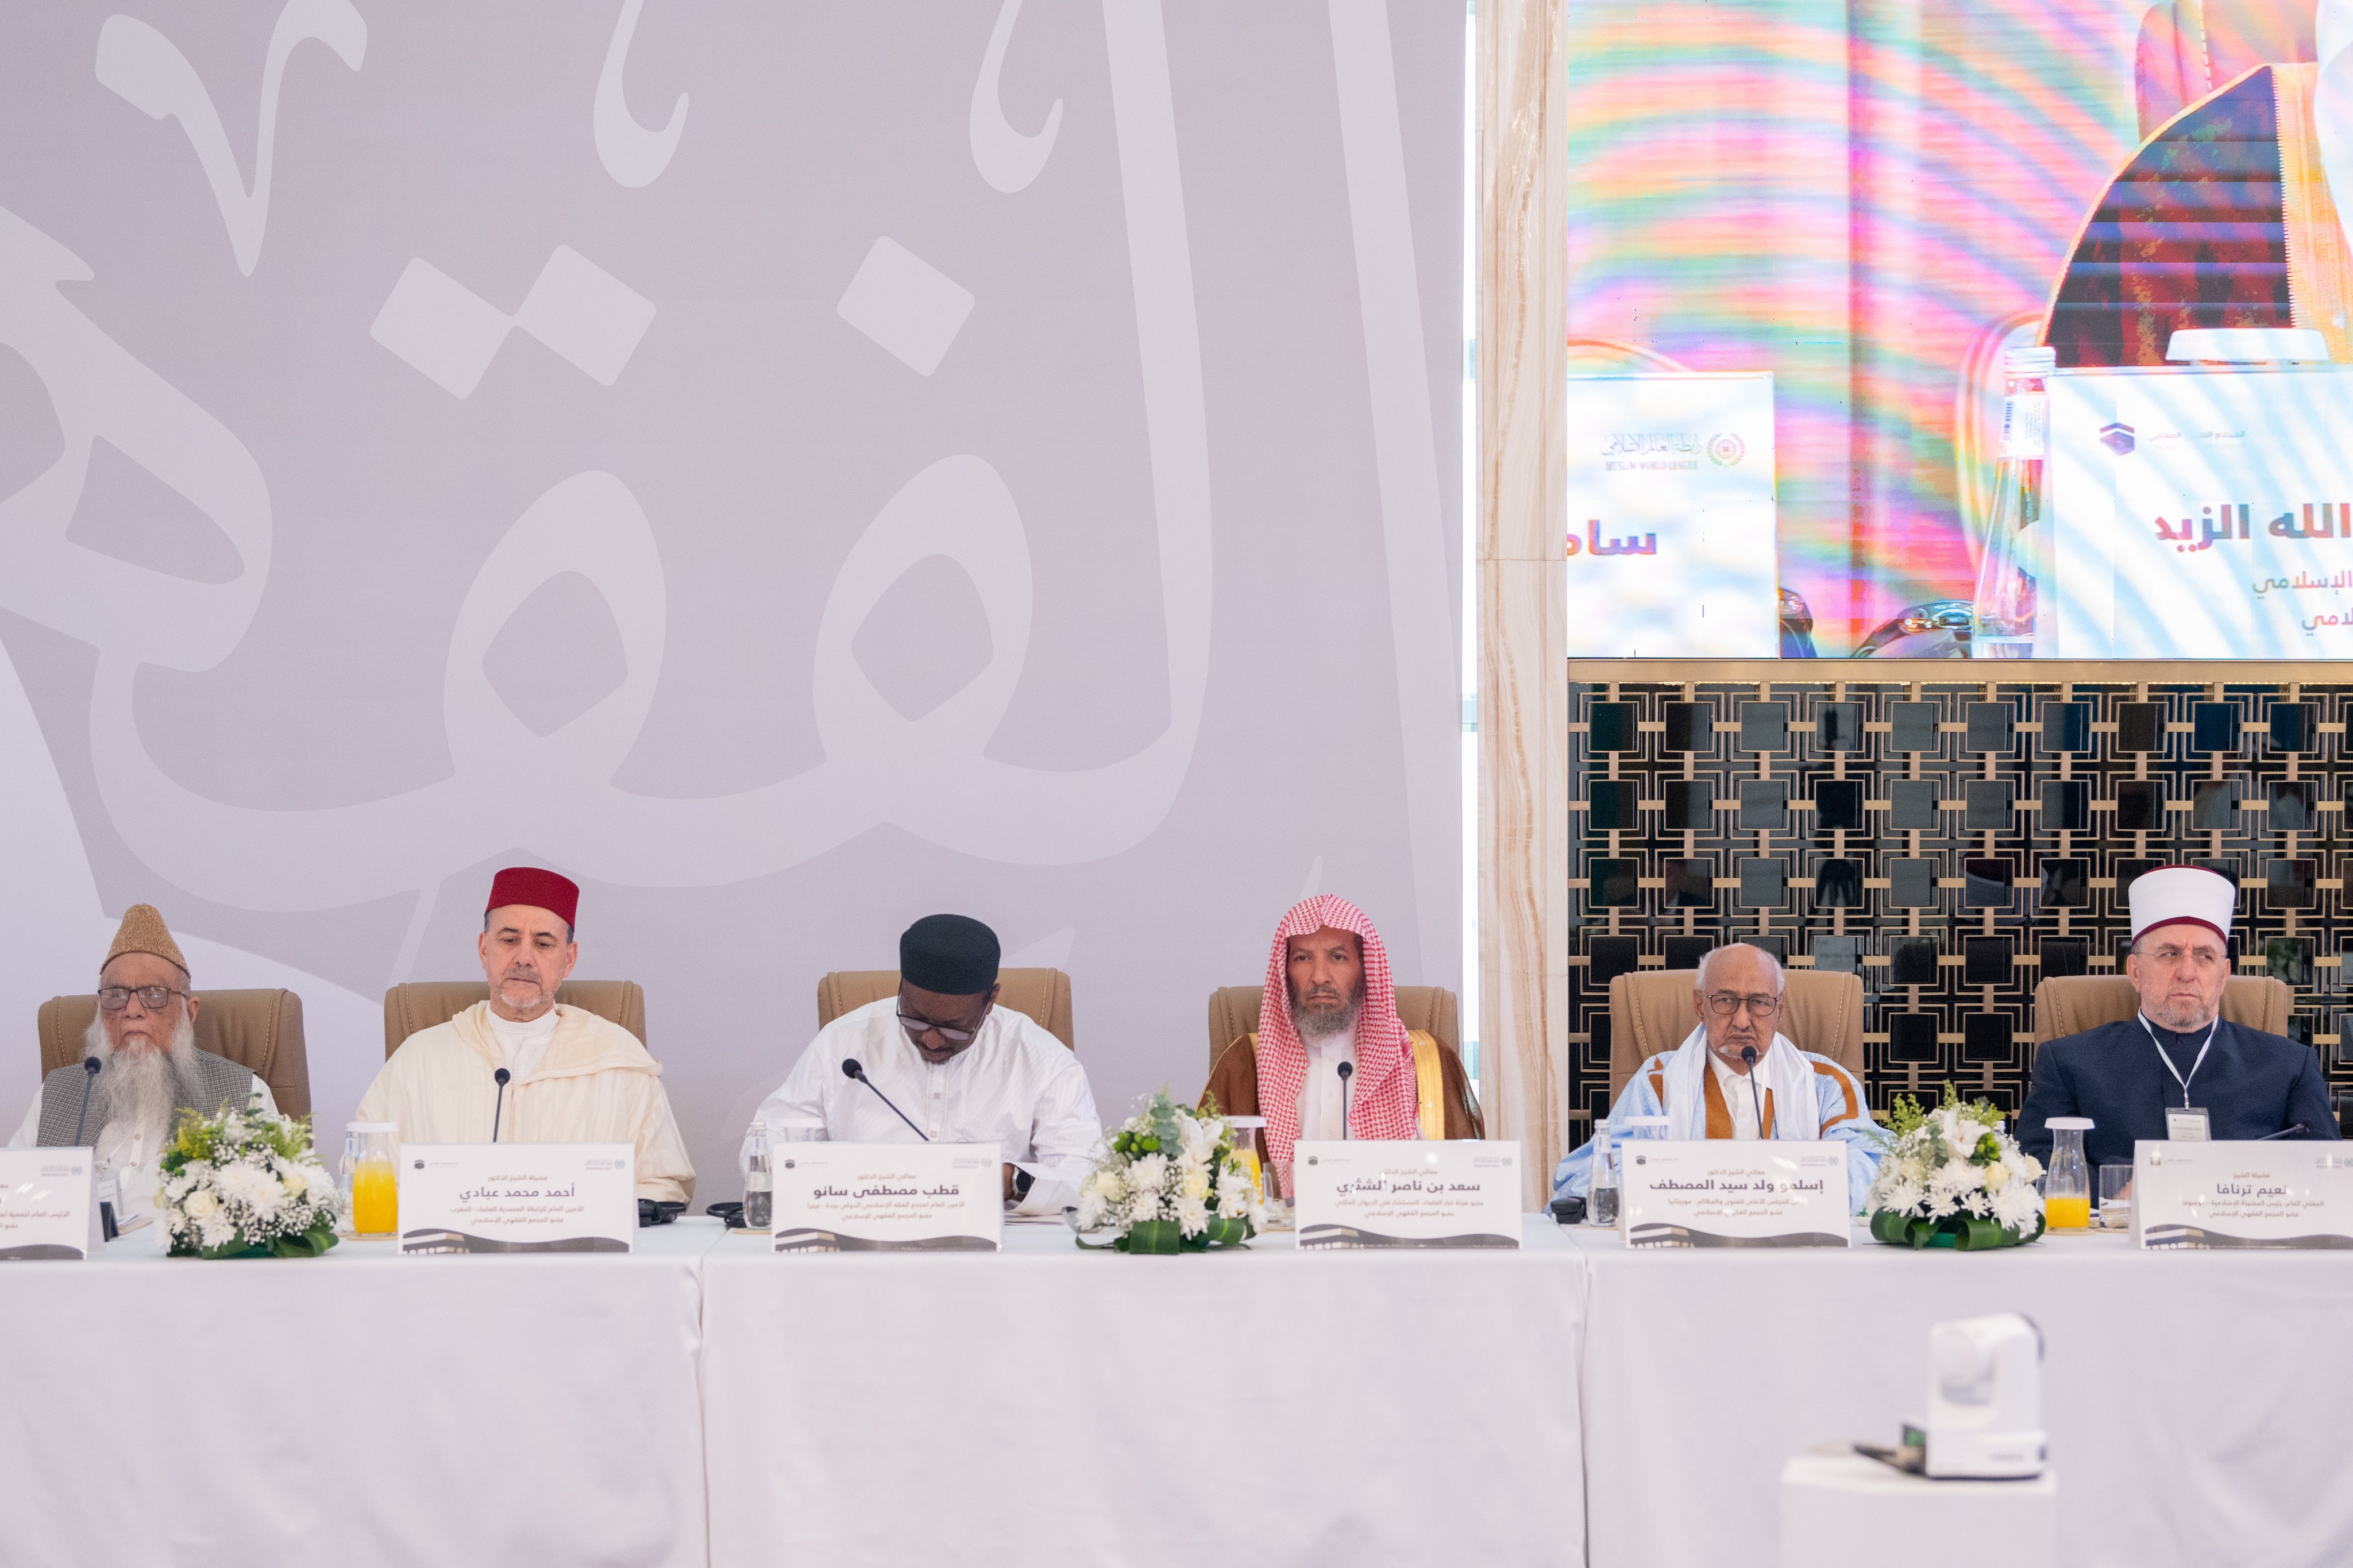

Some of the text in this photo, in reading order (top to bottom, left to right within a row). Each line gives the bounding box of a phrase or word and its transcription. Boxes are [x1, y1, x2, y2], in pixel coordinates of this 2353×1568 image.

[2154, 504, 2250, 553] الزيد
[2252, 570, 2352, 599] الإسلامي
[545, 1182, 575, 1197] أحمد
[813, 1184, 959, 1199] قطب مصطفى سانو
[1391, 1180, 1422, 1194] ناصر
[1426, 1183, 1444, 1195] بن
[1649, 1179, 1715, 1190] المصطف
[1719, 1182, 1748, 1194] سيد
[1752, 1179, 1775, 1193] ولد
[2216, 1183, 2287, 1198] نعيم ترنافا
[459, 1186, 499, 1203] عبادي
[2181, 1200, 2205, 1209] وسوفا
